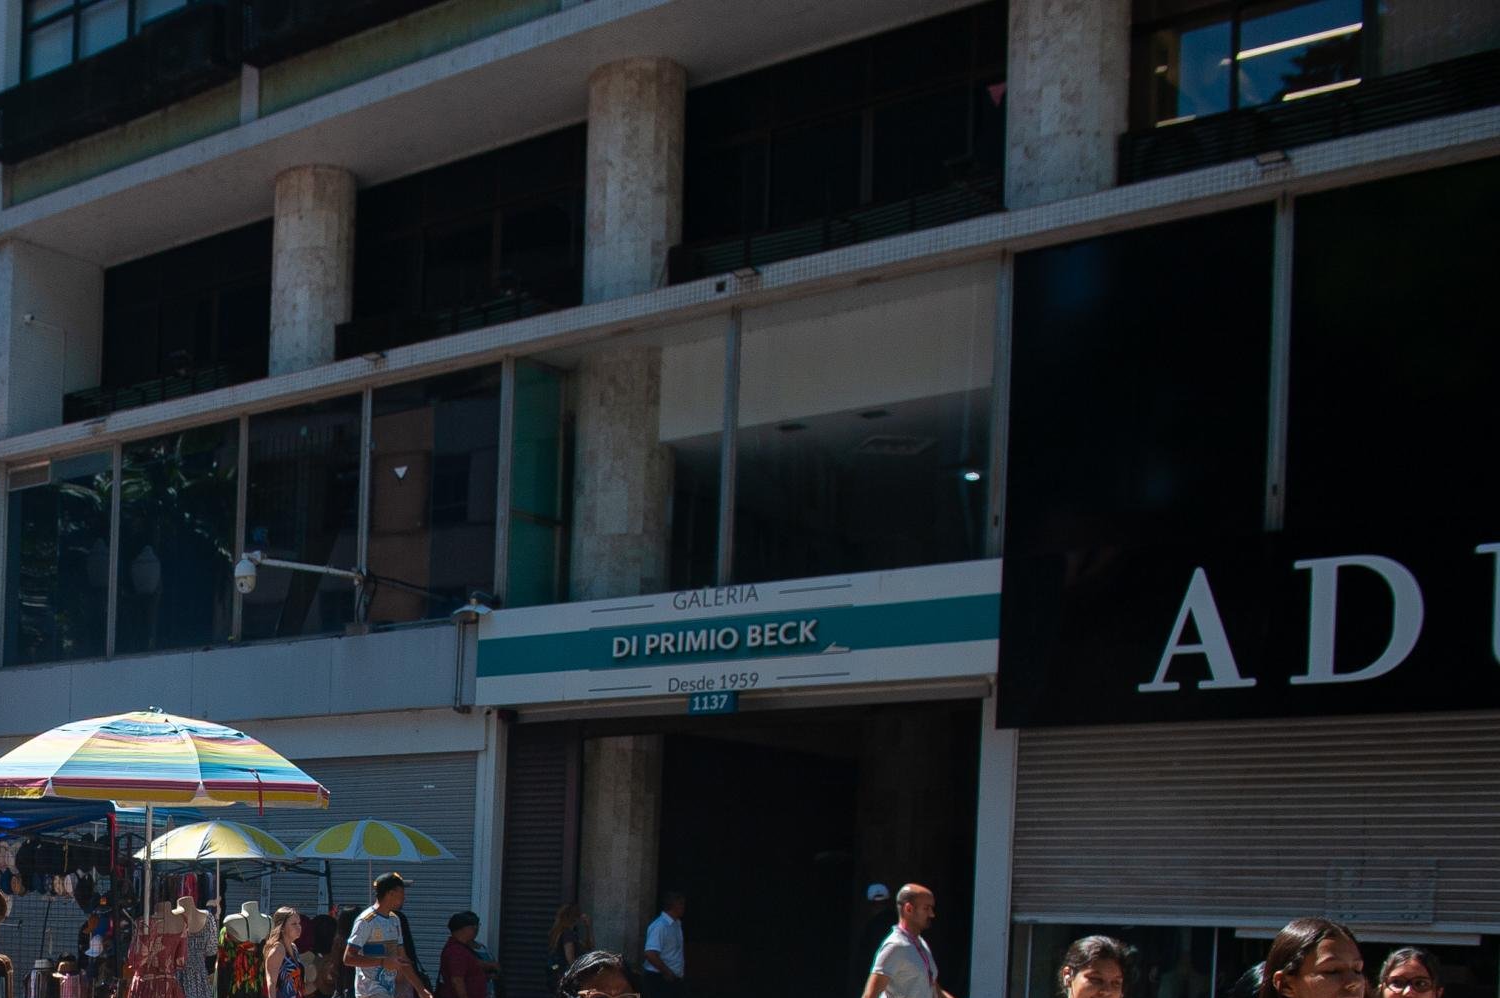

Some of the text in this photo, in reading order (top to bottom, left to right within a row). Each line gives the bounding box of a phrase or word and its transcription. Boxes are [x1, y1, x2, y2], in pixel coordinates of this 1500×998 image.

[673, 584, 760, 610] GALERIA
[611, 618, 818, 659] DI PRIMIO BECK
[668, 671, 760, 692] Desde 1959
[692, 694, 729, 712] 1137
